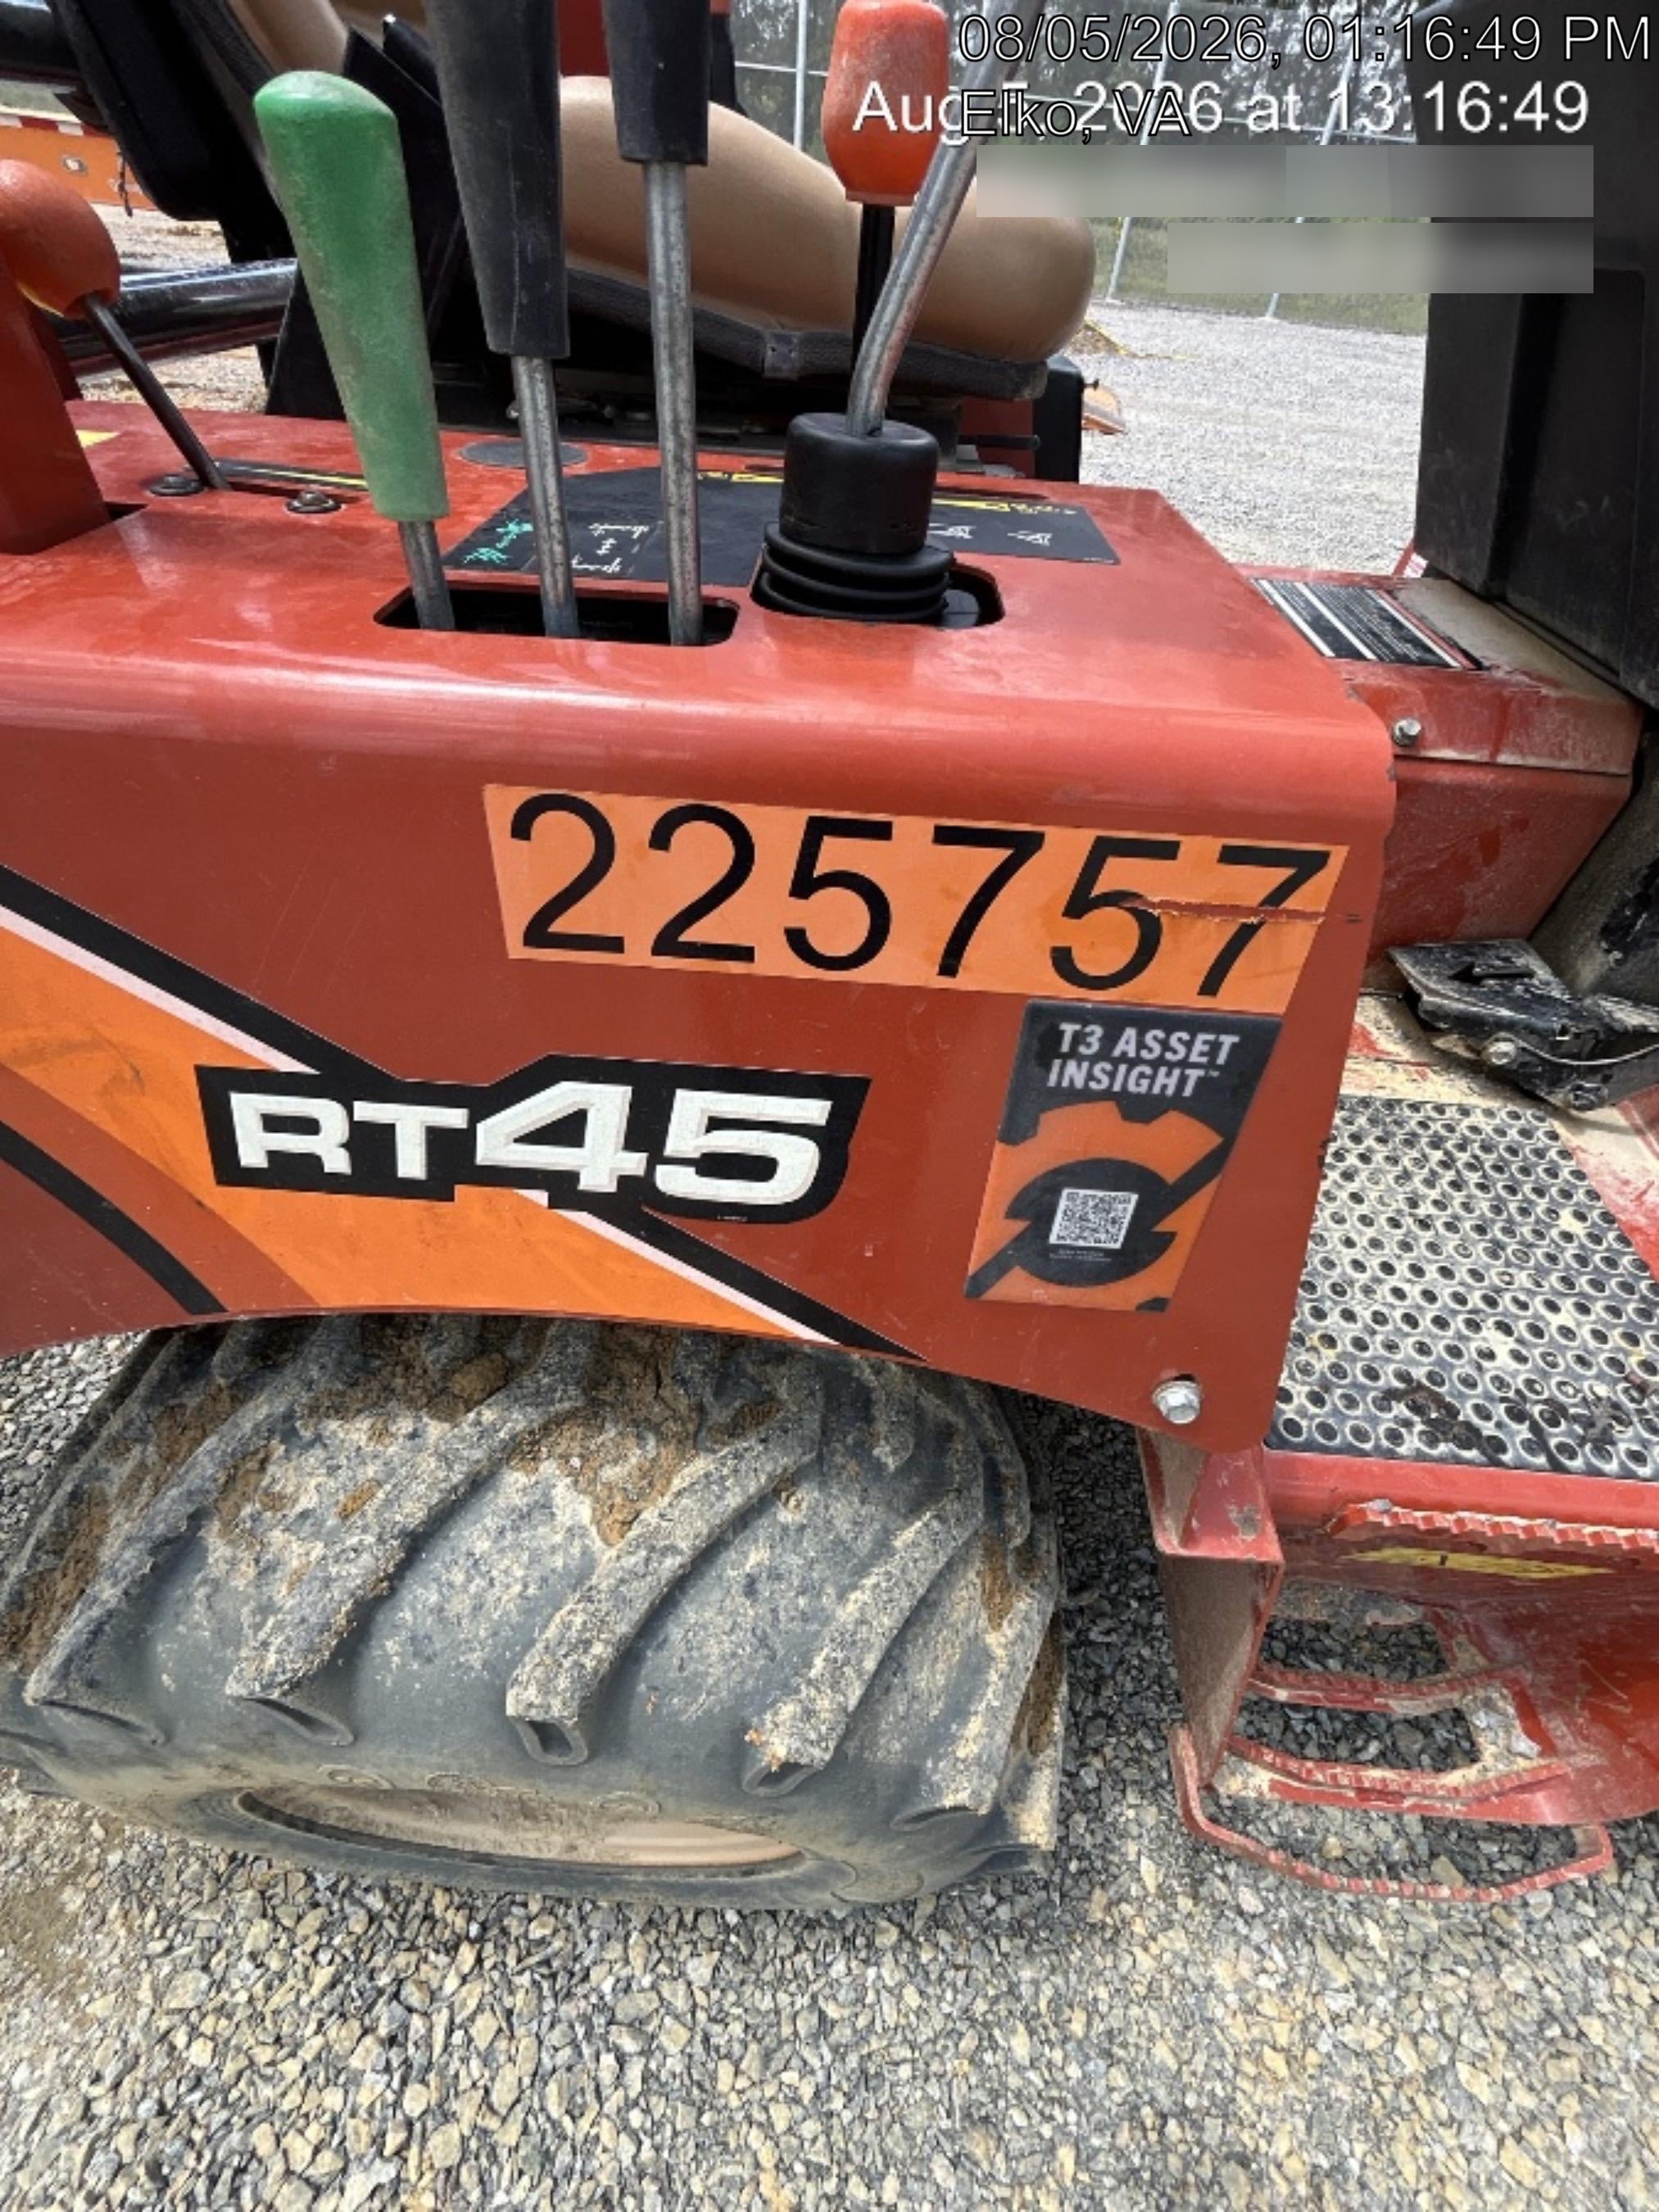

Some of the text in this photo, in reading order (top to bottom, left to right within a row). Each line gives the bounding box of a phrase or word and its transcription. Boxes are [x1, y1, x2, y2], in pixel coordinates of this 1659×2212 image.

[509, 791, 1333, 998] 225757
[1057, 1021, 1240, 1066] T3 ASSET
[228, 1079, 834, 1207] RT45
